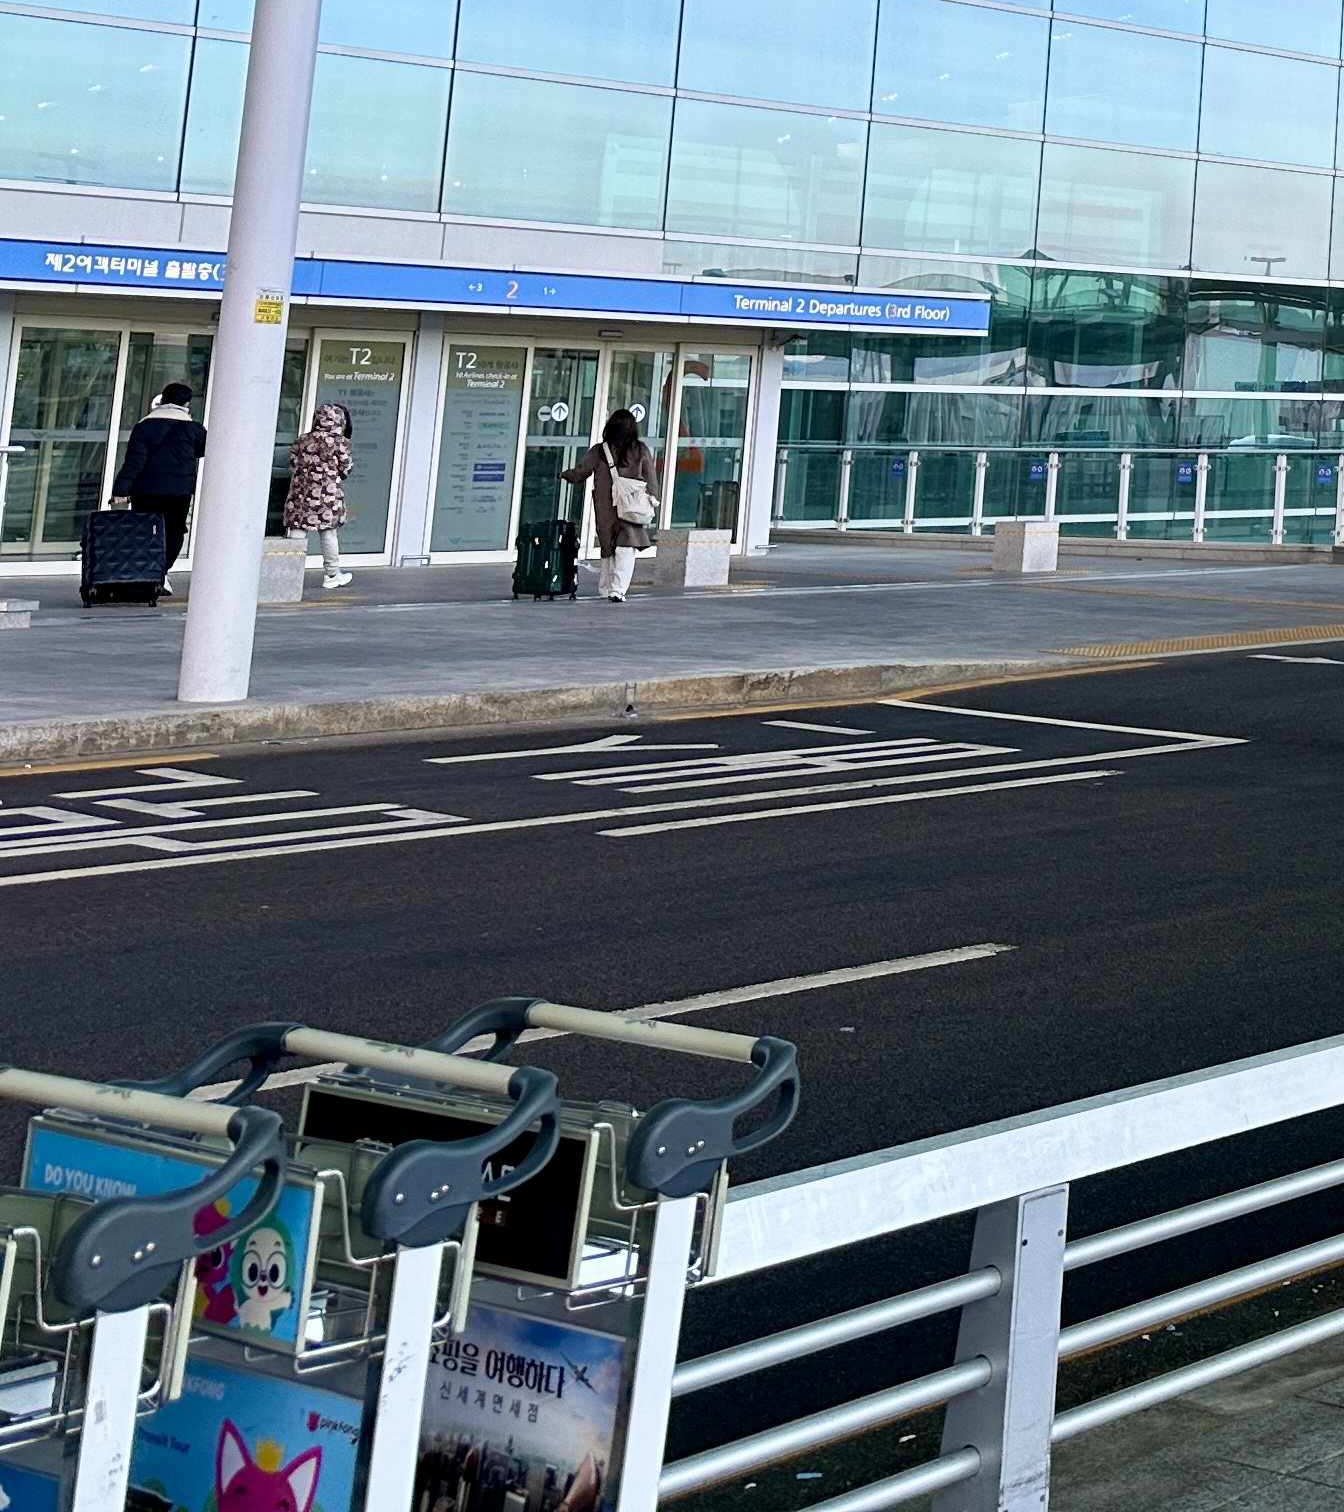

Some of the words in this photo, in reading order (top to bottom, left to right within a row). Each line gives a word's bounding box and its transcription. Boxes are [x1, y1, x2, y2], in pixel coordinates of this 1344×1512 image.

[45, 253, 159, 277] 제2여객터미널
[506, 280, 519, 299] 2
[734, 294, 792, 313] Terminal
[795, 299, 804, 313] 2
[809, 300, 882, 318] Departures
[885, 302, 911, 320] (3rd
[914, 304, 950, 321] Floor)
[349, 347, 372, 365] T2
[455, 352, 477, 369] T2
[353, 371, 389, 381] Terminal
[44, 1163, 63, 1186] DO
[64, 1168, 94, 1194] YOU
[485, 1349, 565, 1399] 여행하다
